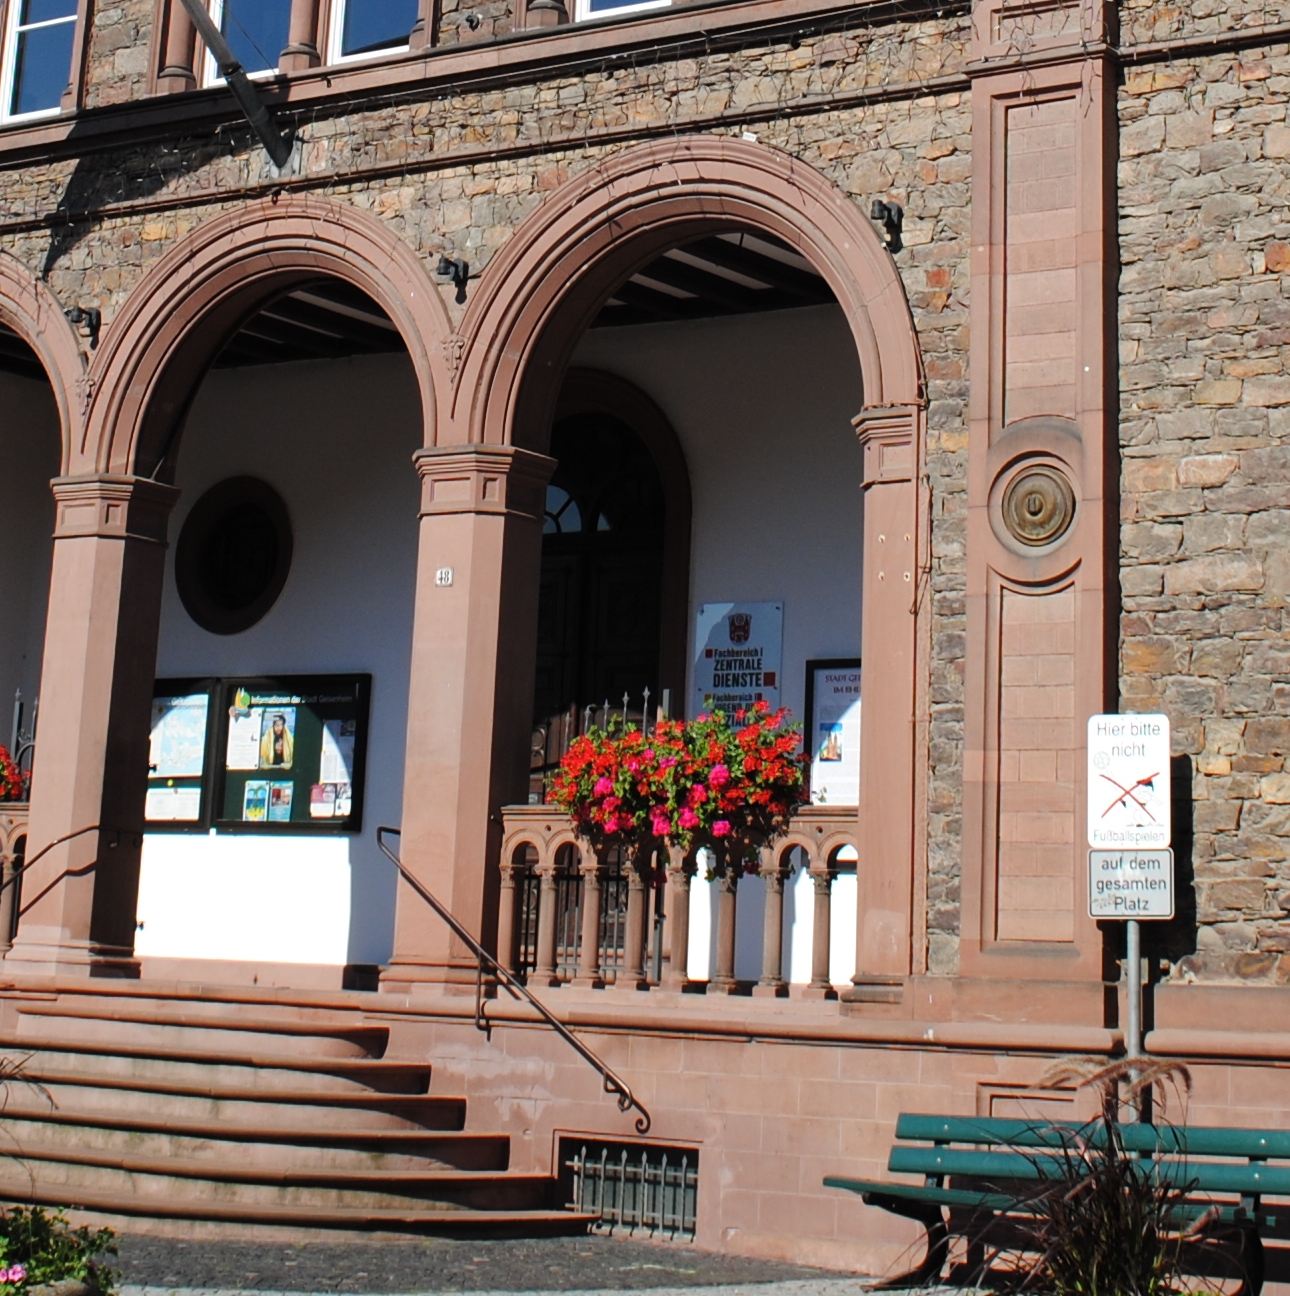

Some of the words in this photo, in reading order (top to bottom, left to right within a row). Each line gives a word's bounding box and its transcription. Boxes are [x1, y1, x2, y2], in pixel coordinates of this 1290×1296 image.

[437, 569, 450, 584] 48
[714, 647, 759, 658] Fachbereich
[714, 658, 763, 672] ZENTRALE
[713, 672, 762, 688] DIENSTE
[1096, 721, 1126, 737] Hier
[1130, 721, 1161, 737] bitte
[1111, 743, 1146, 758] nicht
[1093, 829, 1165, 845] Fußballspielen
[1101, 855, 1124, 871] auf
[1129, 855, 1161, 871] dem
[1096, 878, 1167, 894] gesamten
[1114, 896, 1150, 912] Platz
